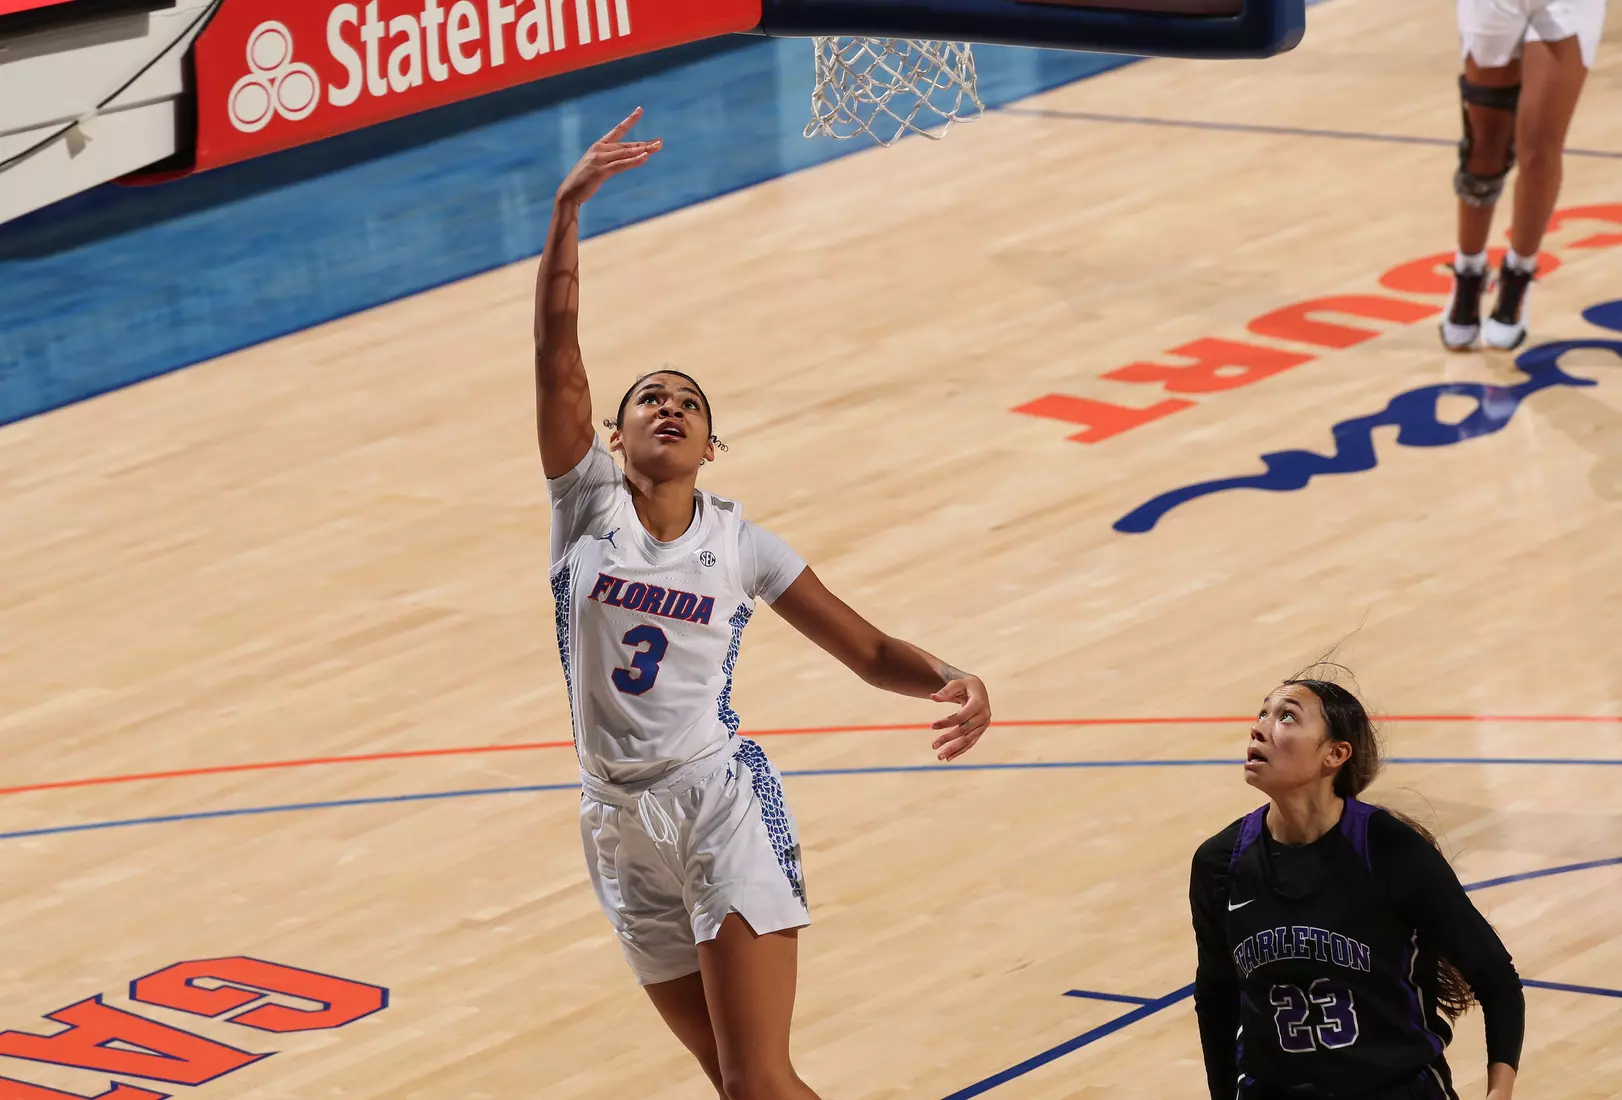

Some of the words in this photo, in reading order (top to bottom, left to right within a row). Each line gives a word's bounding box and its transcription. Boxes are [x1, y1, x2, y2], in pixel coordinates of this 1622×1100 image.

[700, 551, 716, 567] SEC
[588, 572, 715, 625] FLORIDA
[611, 624, 669, 696] 3
[1233, 925, 1371, 979] TARLETON
[1269, 977, 1360, 1053] 23
